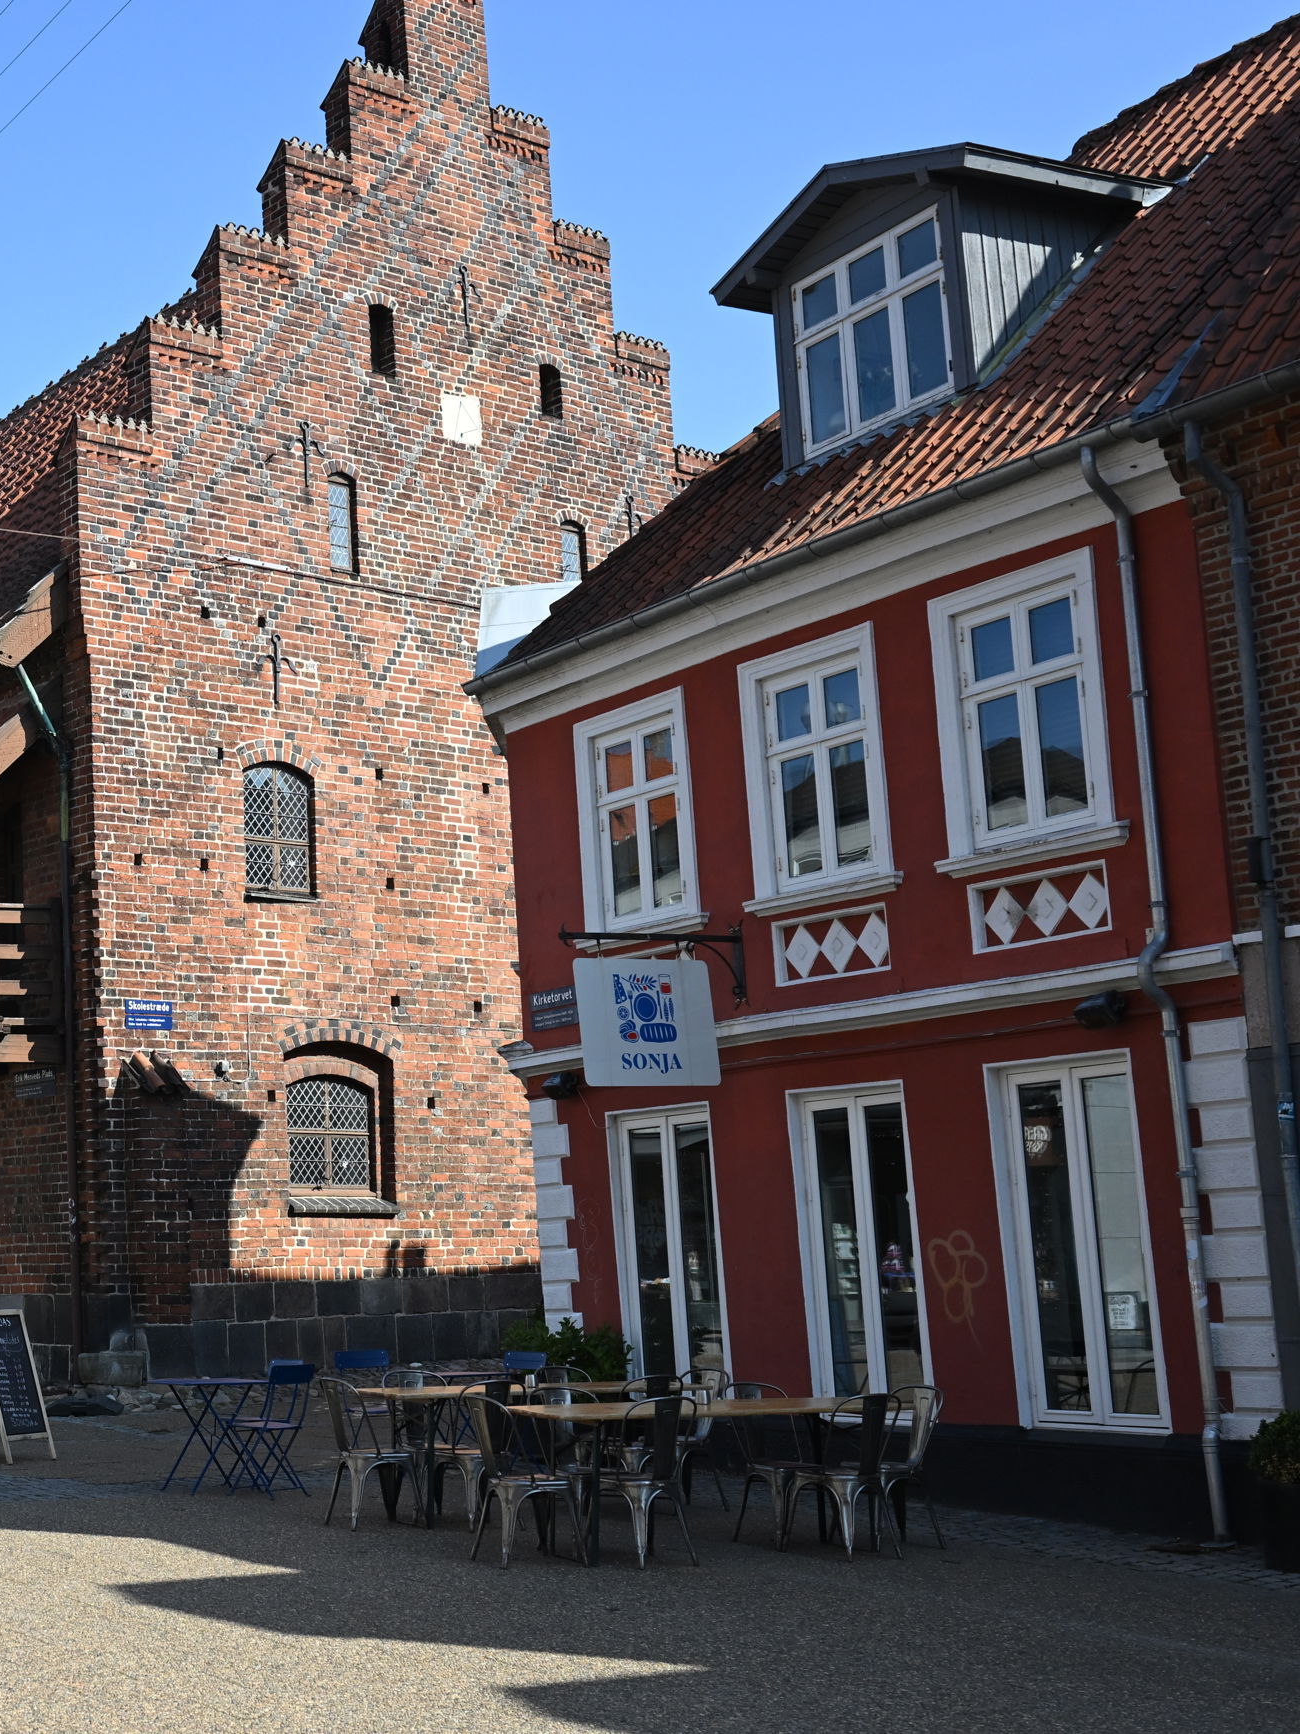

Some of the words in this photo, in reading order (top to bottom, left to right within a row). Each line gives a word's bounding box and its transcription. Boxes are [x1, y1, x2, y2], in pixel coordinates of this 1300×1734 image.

[128, 1001, 170, 1012] Skolestræde
[533, 988, 573, 1007] Kirketorvet
[621, 1053, 683, 1074] SONJA
